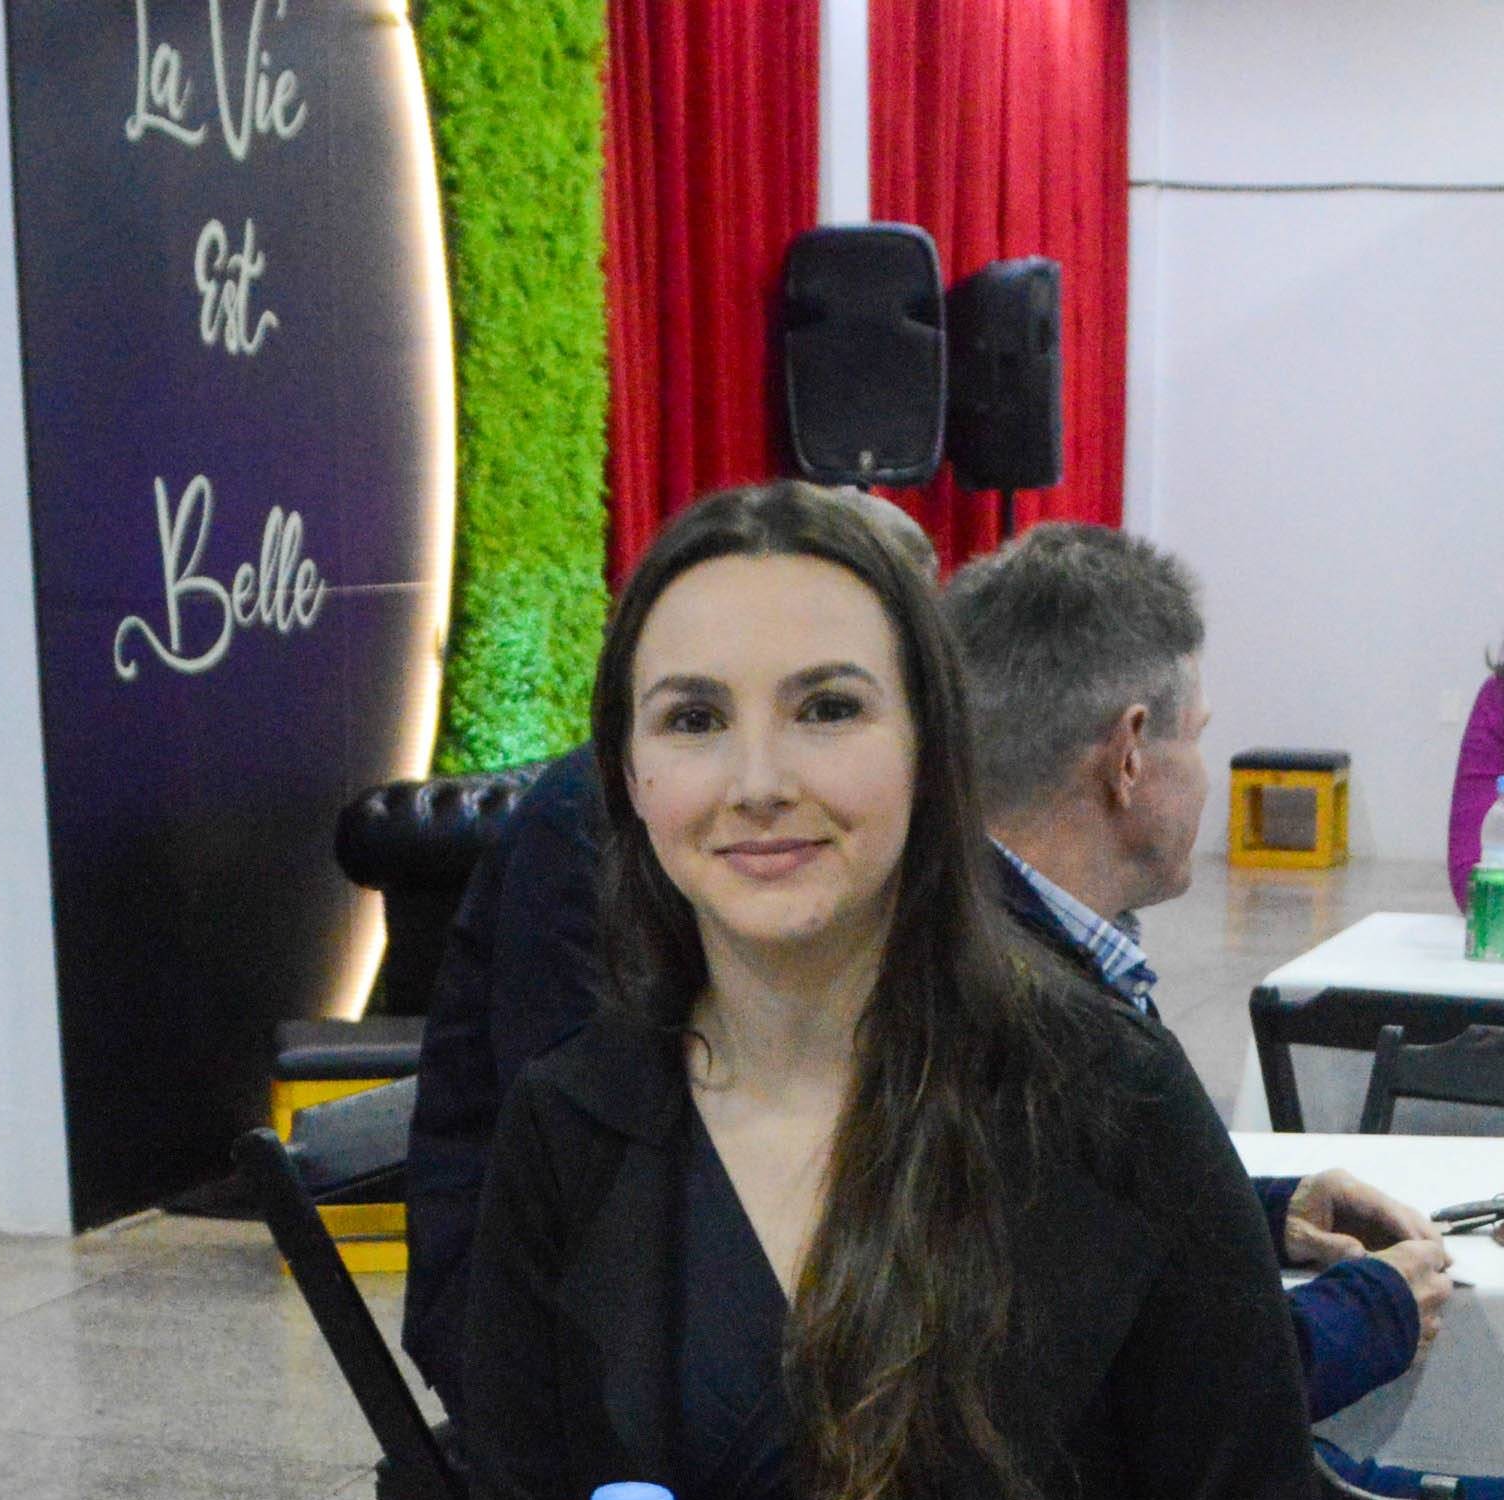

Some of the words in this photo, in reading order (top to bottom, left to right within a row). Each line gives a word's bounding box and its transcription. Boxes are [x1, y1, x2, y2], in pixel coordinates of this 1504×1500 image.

[125, 0, 205, 143] La
[209, 0, 307, 161] Vie
[195, 218, 280, 355] Est
[114, 473, 326, 682] Belle
